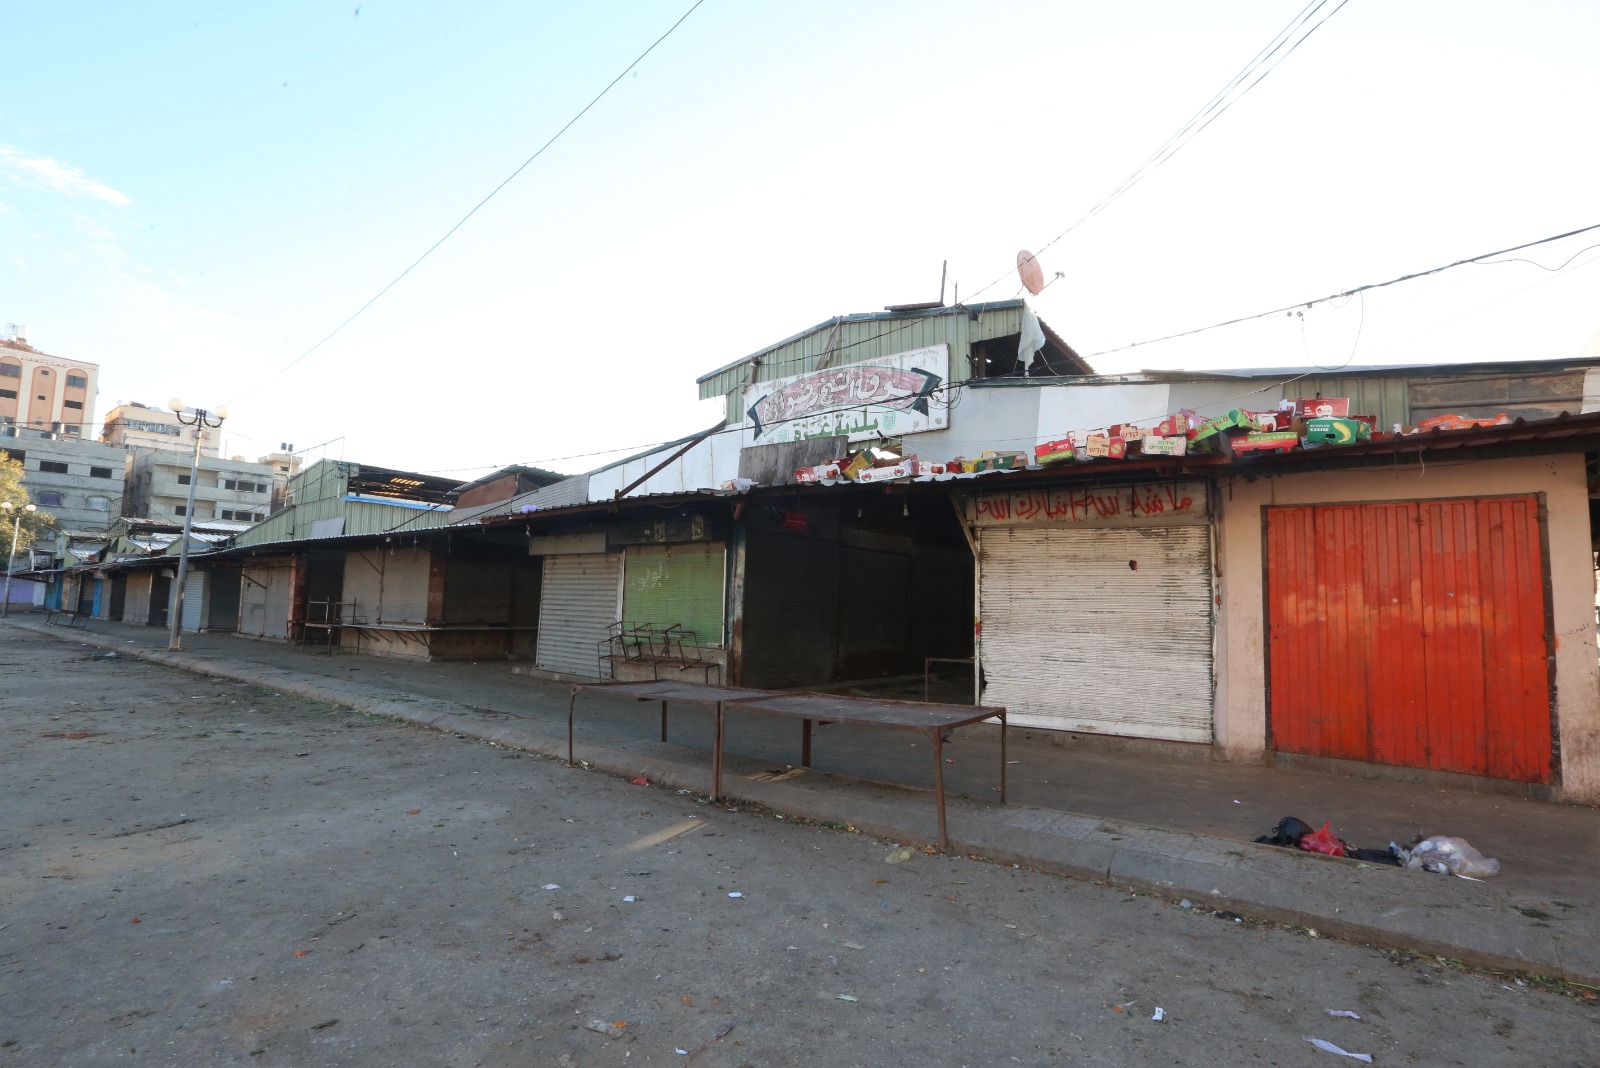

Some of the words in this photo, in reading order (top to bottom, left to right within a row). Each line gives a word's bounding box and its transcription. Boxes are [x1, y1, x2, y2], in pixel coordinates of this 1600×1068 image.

[819, 371, 855, 405] الشيخ
[856, 374, 917, 405] سوق
[763, 383, 820, 424] رضوان
[793, 415, 832, 442] غزة
[832, 407, 879, 439] بلدية
[1089, 446, 1106, 454] קדש
[977, 495, 1010, 520] الله
[1165, 485, 1193, 511] ما
